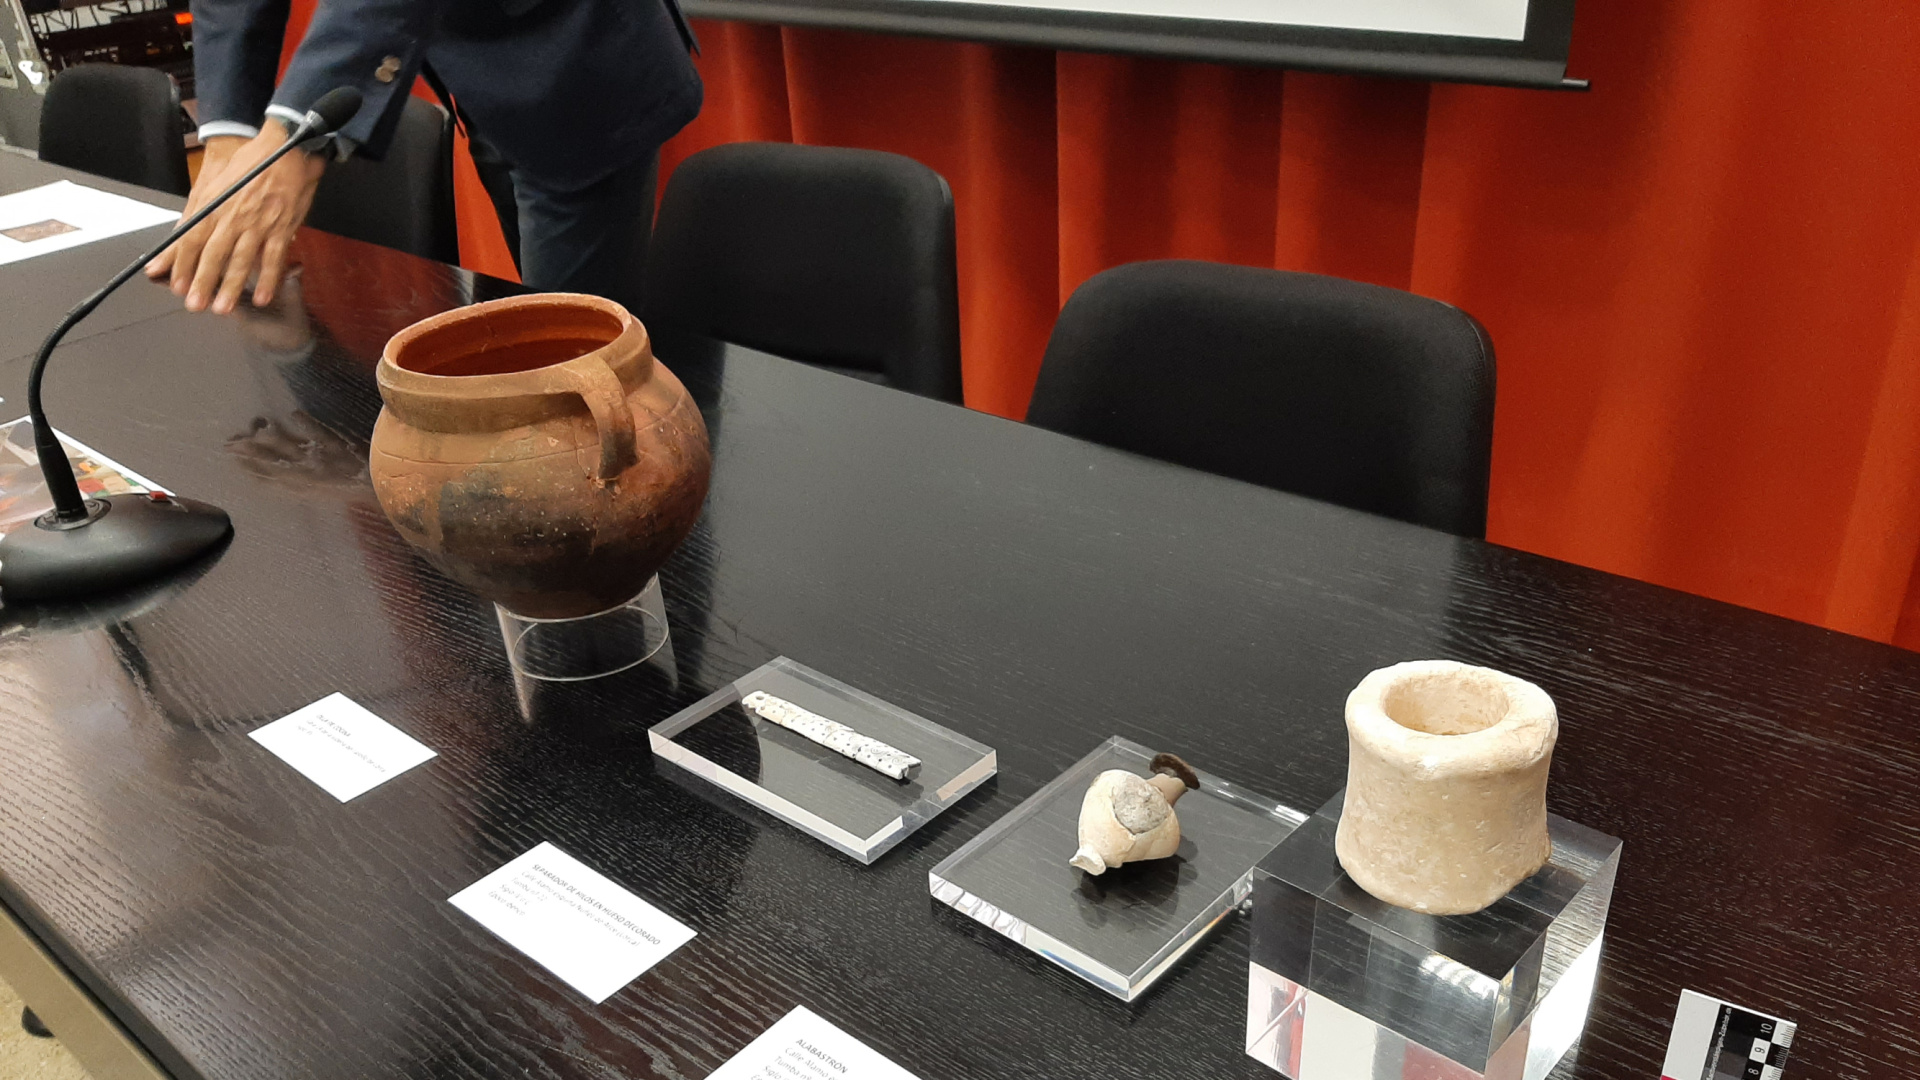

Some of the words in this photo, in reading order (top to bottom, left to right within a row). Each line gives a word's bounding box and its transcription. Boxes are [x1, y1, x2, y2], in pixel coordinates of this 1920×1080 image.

[532, 864, 568, 887] SEPARADOR
[566, 885, 577, 893] DE
[575, 891, 595, 904] HILOS
[592, 901, 604, 910] EN
[602, 907, 625, 923] HUESO
[623, 920, 661, 945] DECORADO
[1760, 1023, 1773, 1034] 10
[785, 1047, 804, 1062] Calle
[774, 1055, 800, 1076] Tumba
